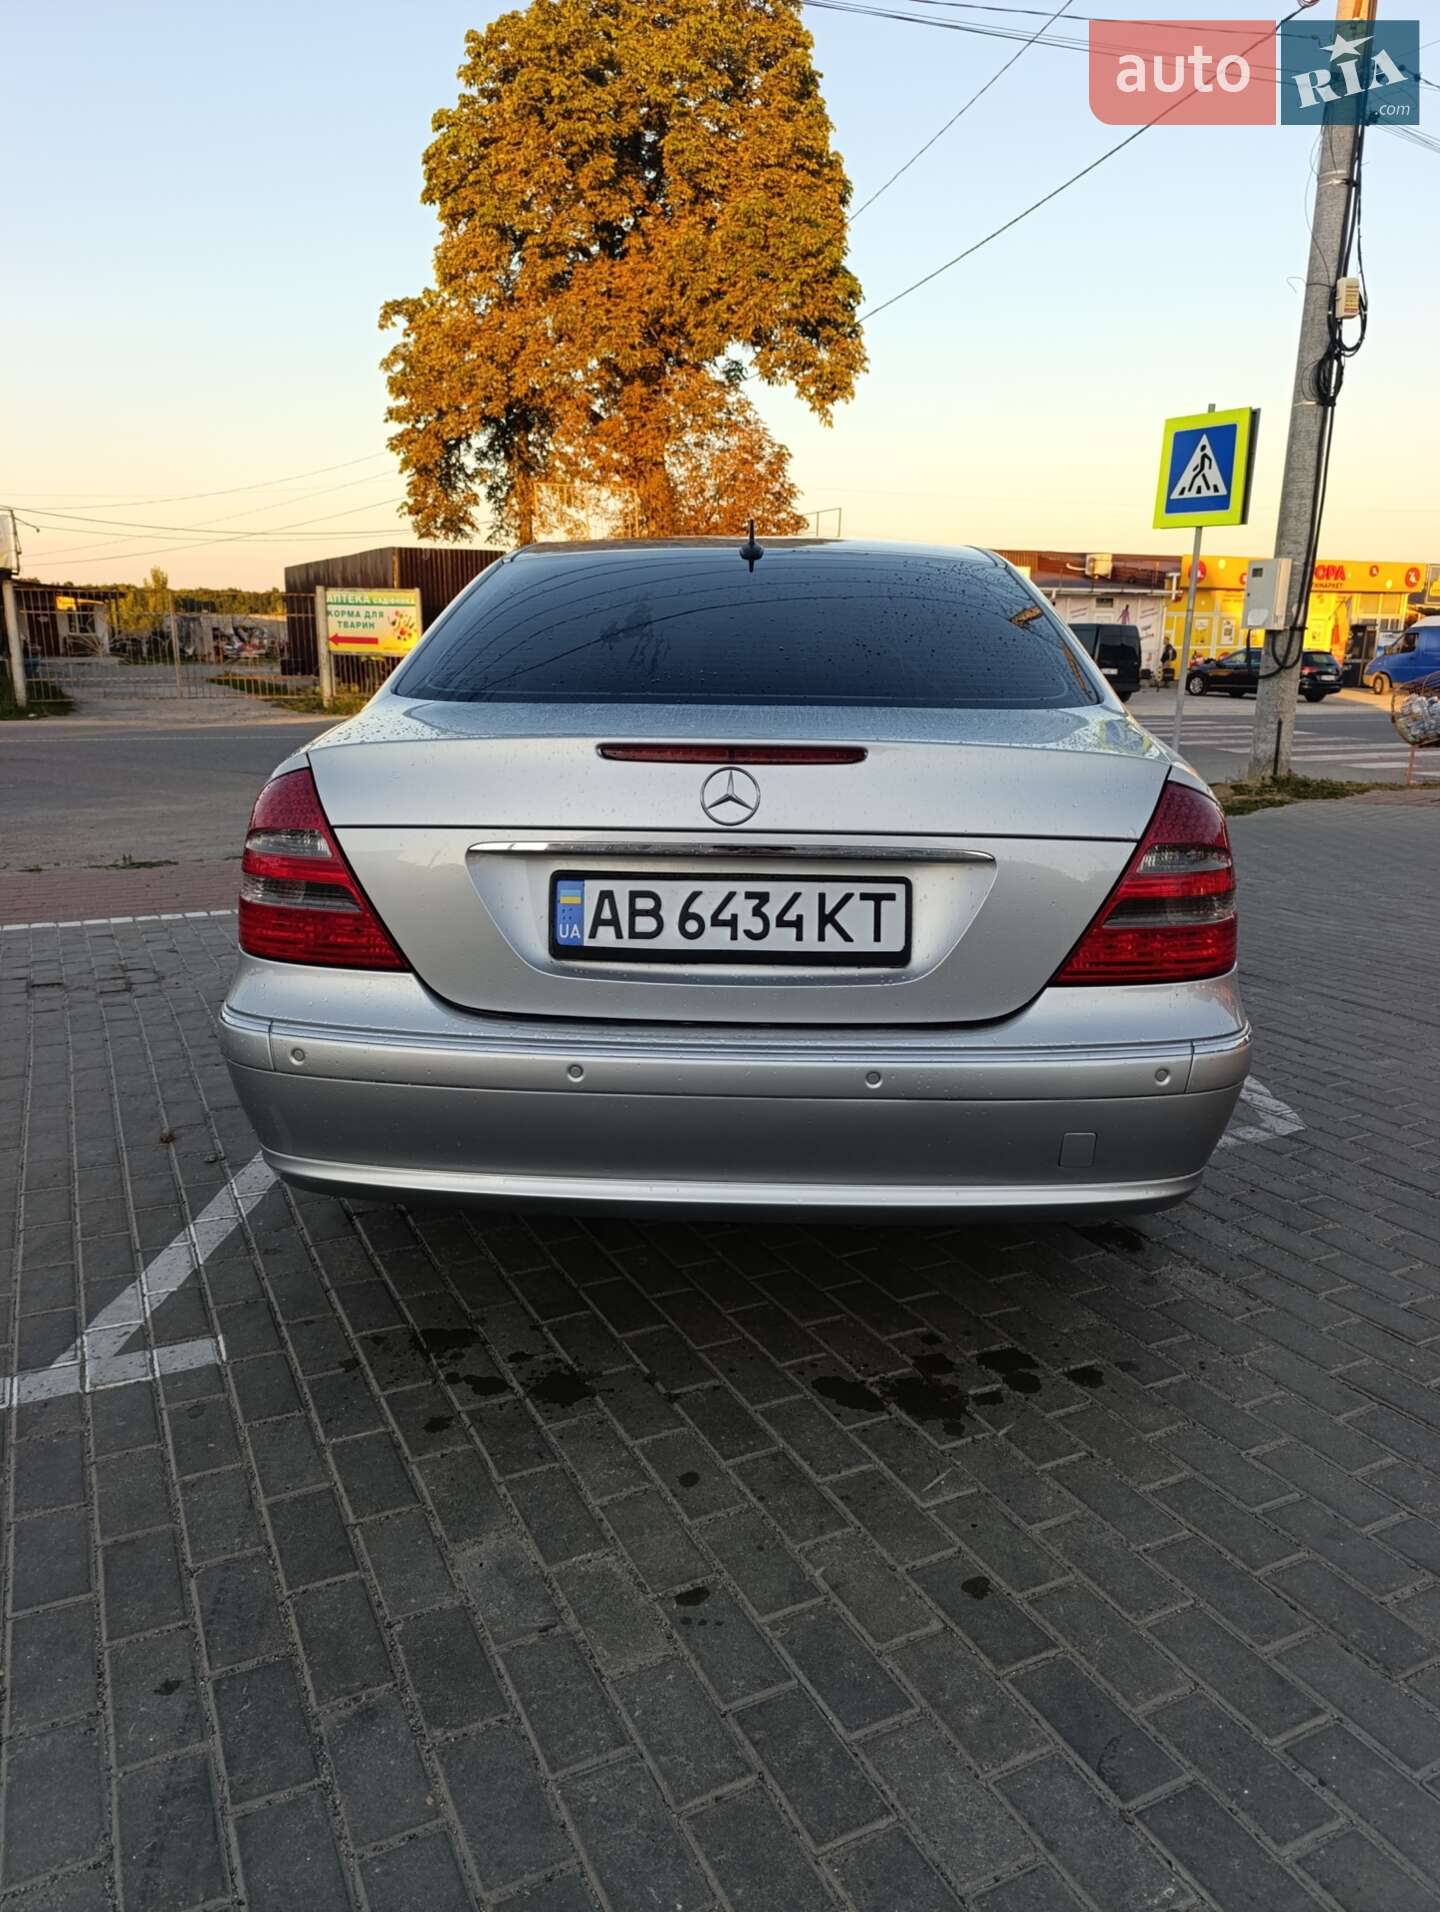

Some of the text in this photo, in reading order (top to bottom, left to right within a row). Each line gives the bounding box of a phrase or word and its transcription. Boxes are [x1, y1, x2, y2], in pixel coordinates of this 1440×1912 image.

[1315, 564, 1346, 580] ОРА
[327, 592, 371, 604] АПТЕКА
[327, 610, 384, 619] КОРМА ДЛЯ
[337, 620, 375, 629] ТВАРИН
[588, 889, 897, 942] AB 6434 KT
[558, 924, 581, 939] UA
